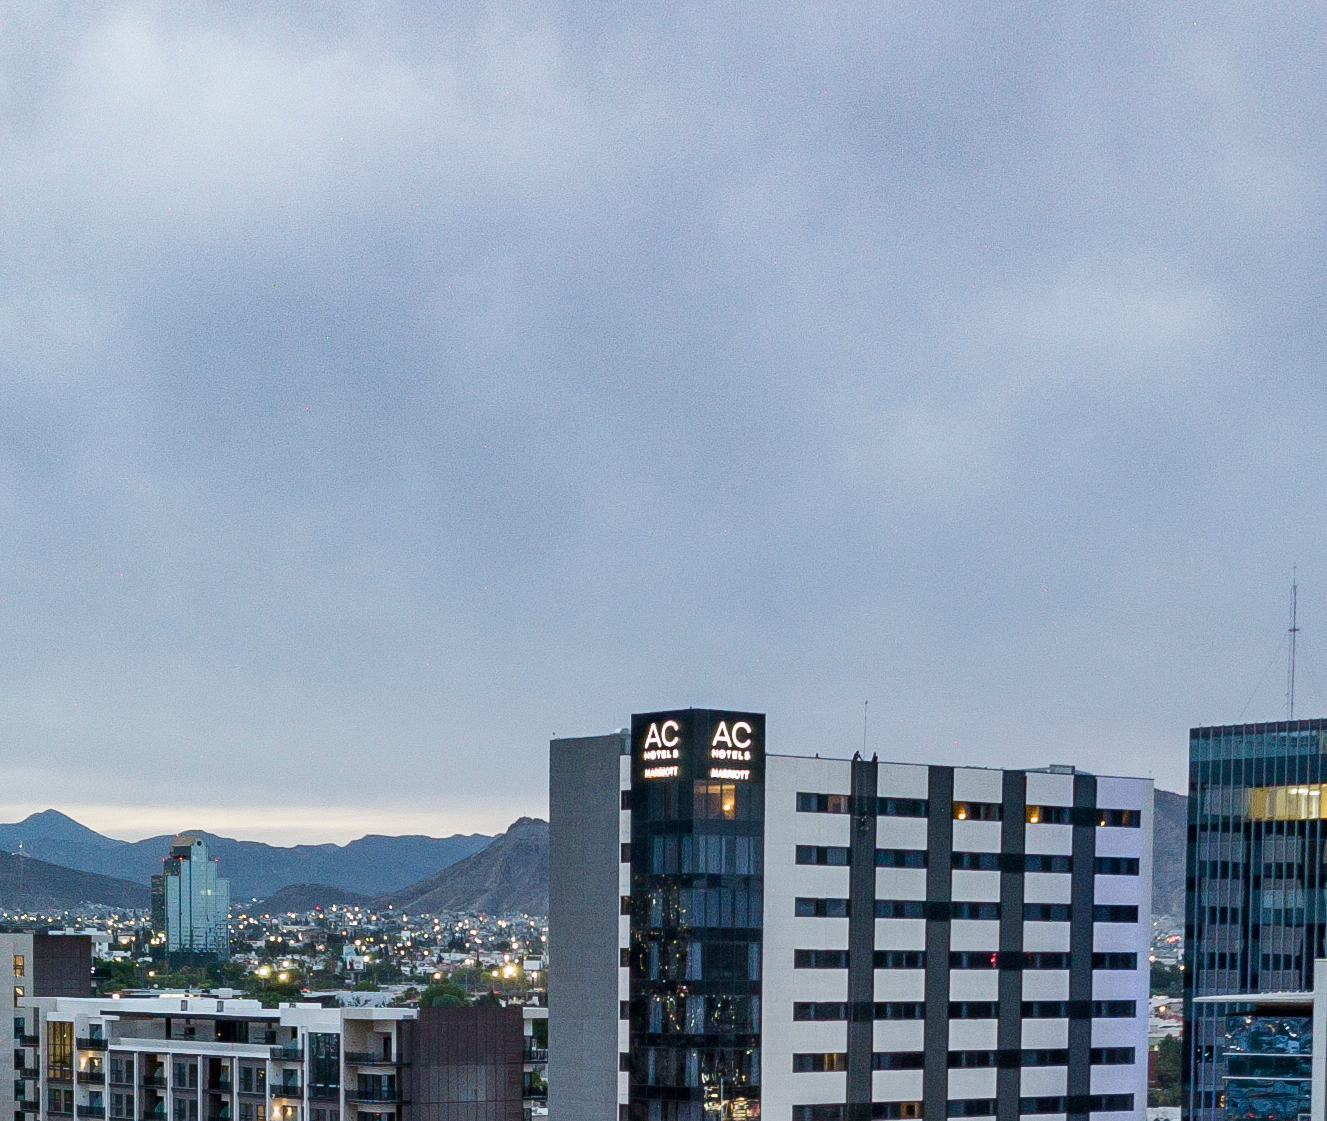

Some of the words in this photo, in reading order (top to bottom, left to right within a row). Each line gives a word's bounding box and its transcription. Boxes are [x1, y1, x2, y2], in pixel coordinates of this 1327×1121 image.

[644, 720, 679, 749] AC
[712, 720, 752, 749] AC
[644, 749, 679, 761] HOTELS
[711, 748, 751, 761] HOTELS
